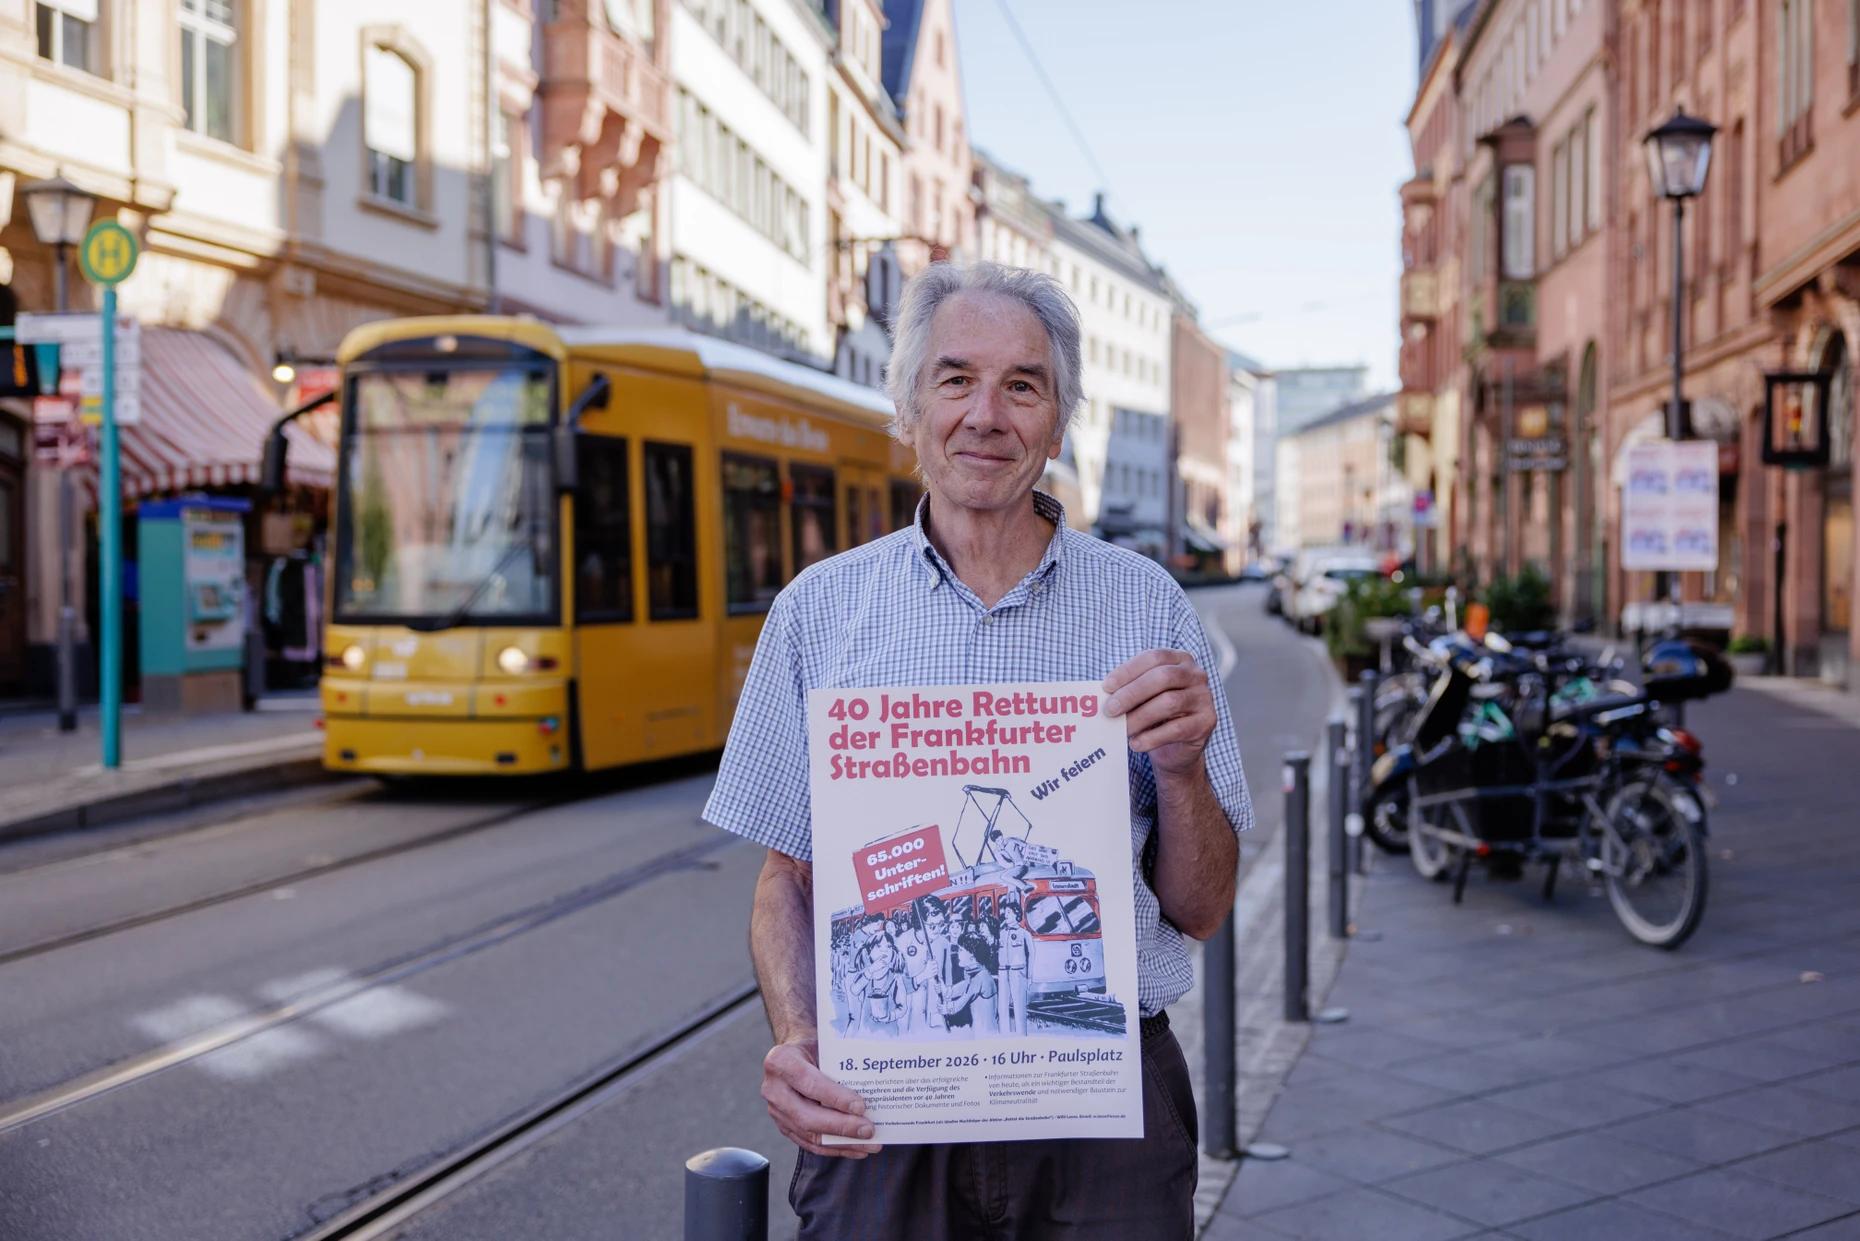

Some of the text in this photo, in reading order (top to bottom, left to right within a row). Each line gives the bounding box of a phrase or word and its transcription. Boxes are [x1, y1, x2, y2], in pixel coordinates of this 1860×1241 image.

[98, 235, 121, 269] H
[828, 691, 1098, 723] 40 Jahre Rettung
[828, 718, 1076, 750] der Frankfurter
[830, 749, 1031, 780] Straßenbahn
[1030, 747, 1106, 801] Wir feiern
[866, 838, 924, 866] 65.000
[867, 864, 946, 901] schriften!
[874, 857, 927, 880] Unter-
[839, 1048, 1123, 1073] 18. September 2026 16 Uhr Paulsplatz
[916, 1085, 948, 1093] Verfügung
[932, 1075, 968, 1084] erfolgreiche
[1050, 1087, 1088, 1095] notwendiger
